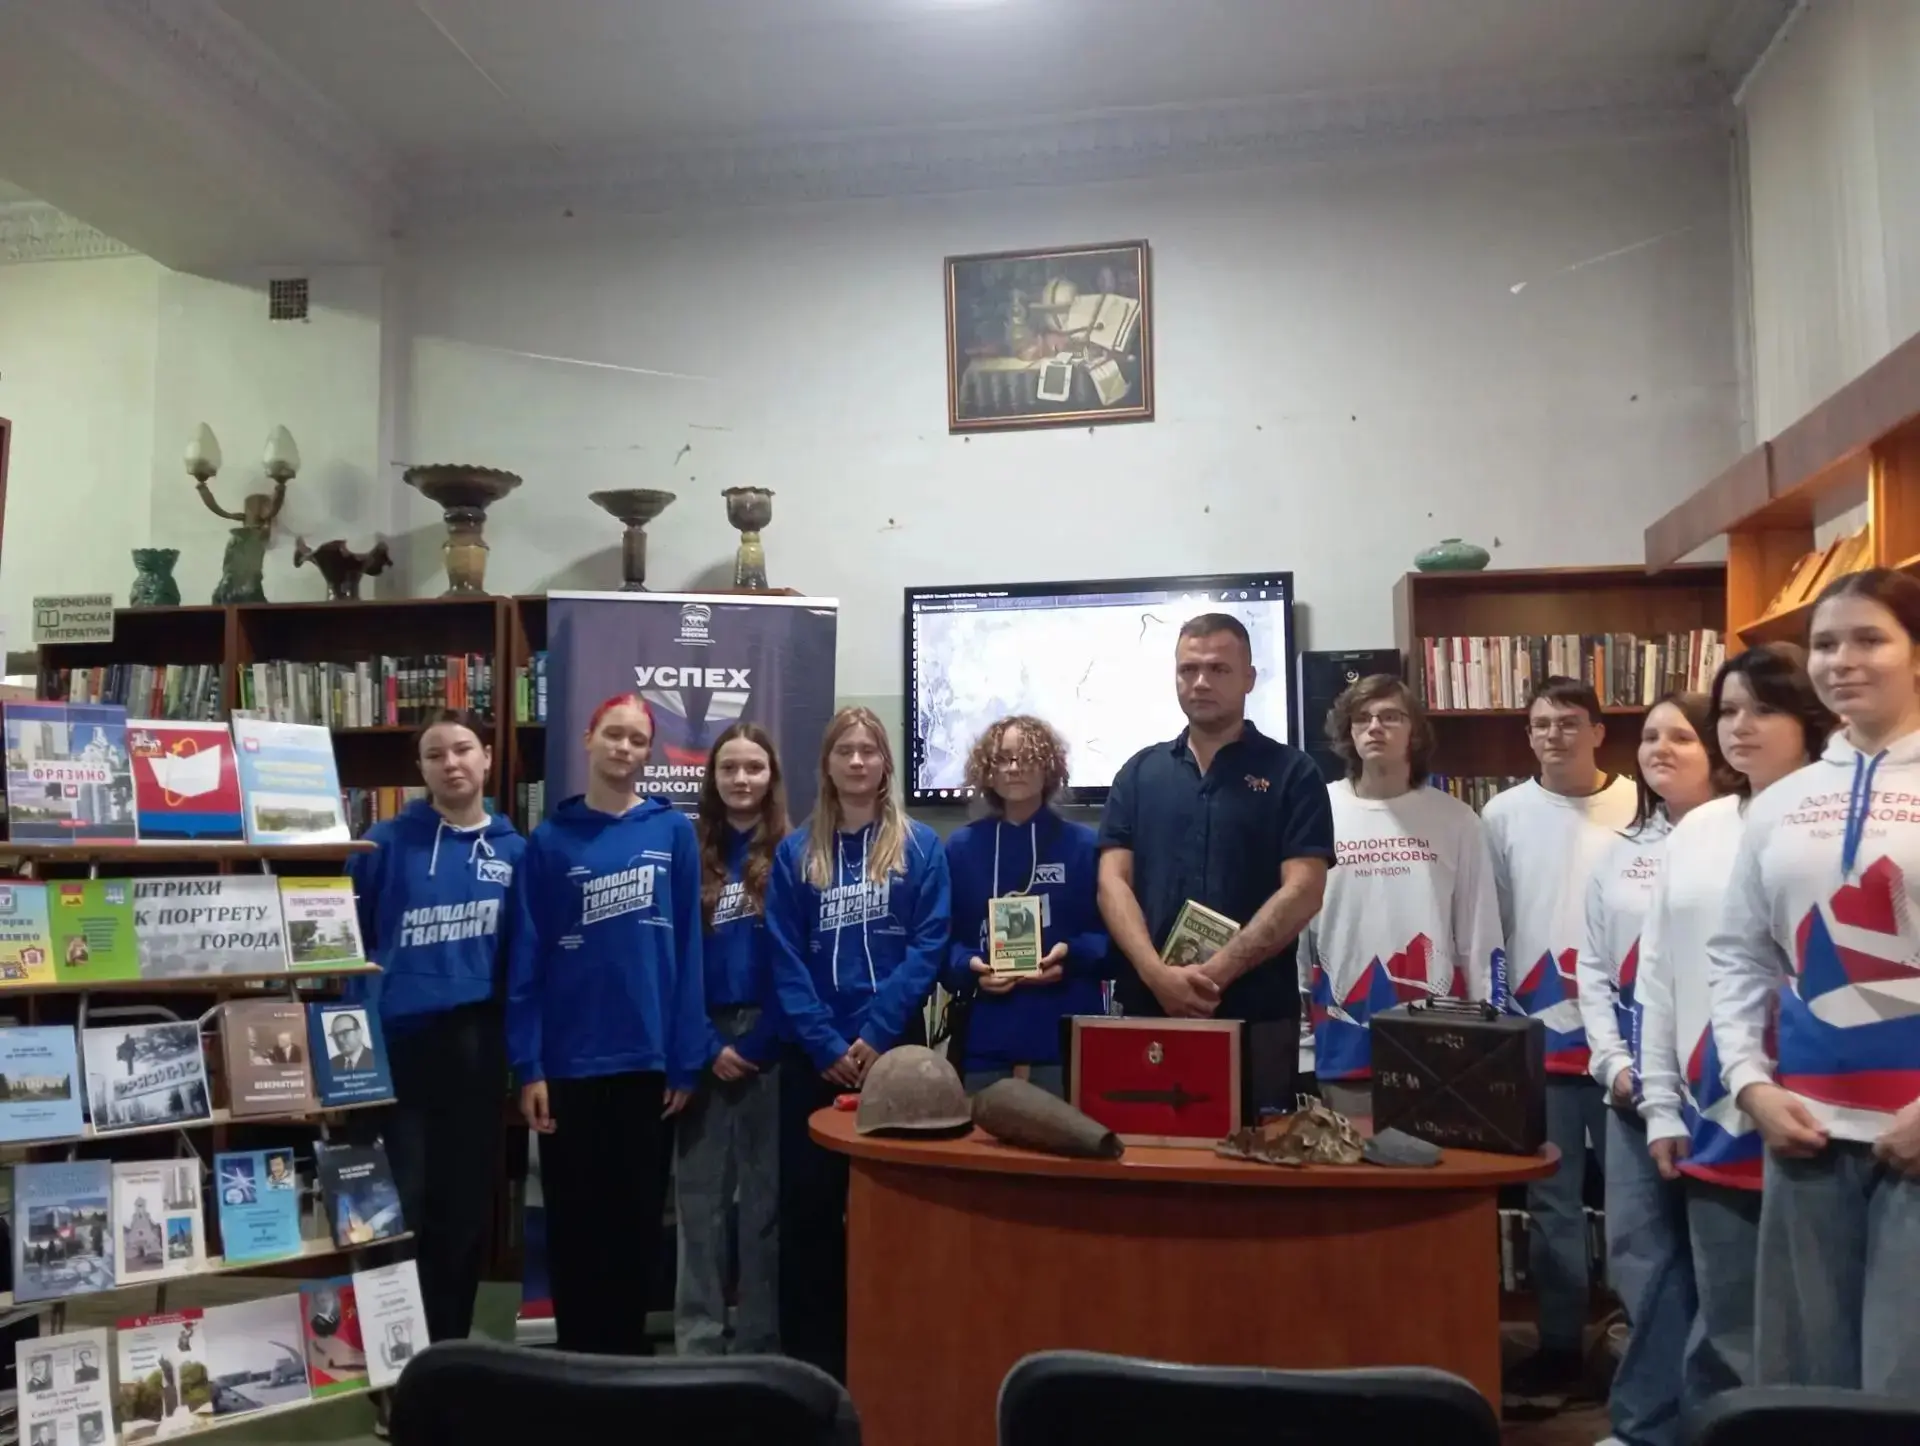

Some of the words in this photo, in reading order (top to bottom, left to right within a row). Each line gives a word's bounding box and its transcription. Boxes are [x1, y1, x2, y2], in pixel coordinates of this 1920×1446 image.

[634, 666, 751, 689] УСПЕХ
[33, 768, 106, 780] ФРЯЗИНО
[643, 765, 706, 779] ЕДИНС
[634, 781, 703, 793] ПОКОЛ
[1336, 838, 1430, 852] ВОЛОНТЕРЫ
[1336, 850, 1439, 866] ОДМОСКОВЬЯ
[583, 864, 655, 895] МОЛОДАЯ
[1354, 869, 1372, 878] МЫ
[1375, 866, 1411, 877] РЯДОМ
[583, 872, 654, 911] ГВАРДИЯ
[134, 910, 151, 926] К
[158, 906, 268, 925] ПОРТРЕТУ
[402, 899, 499, 928] МОЛОДАЯ
[400, 910, 498, 948] ГВАРДИЯ
[200, 932, 280, 951] ГОРОДА
